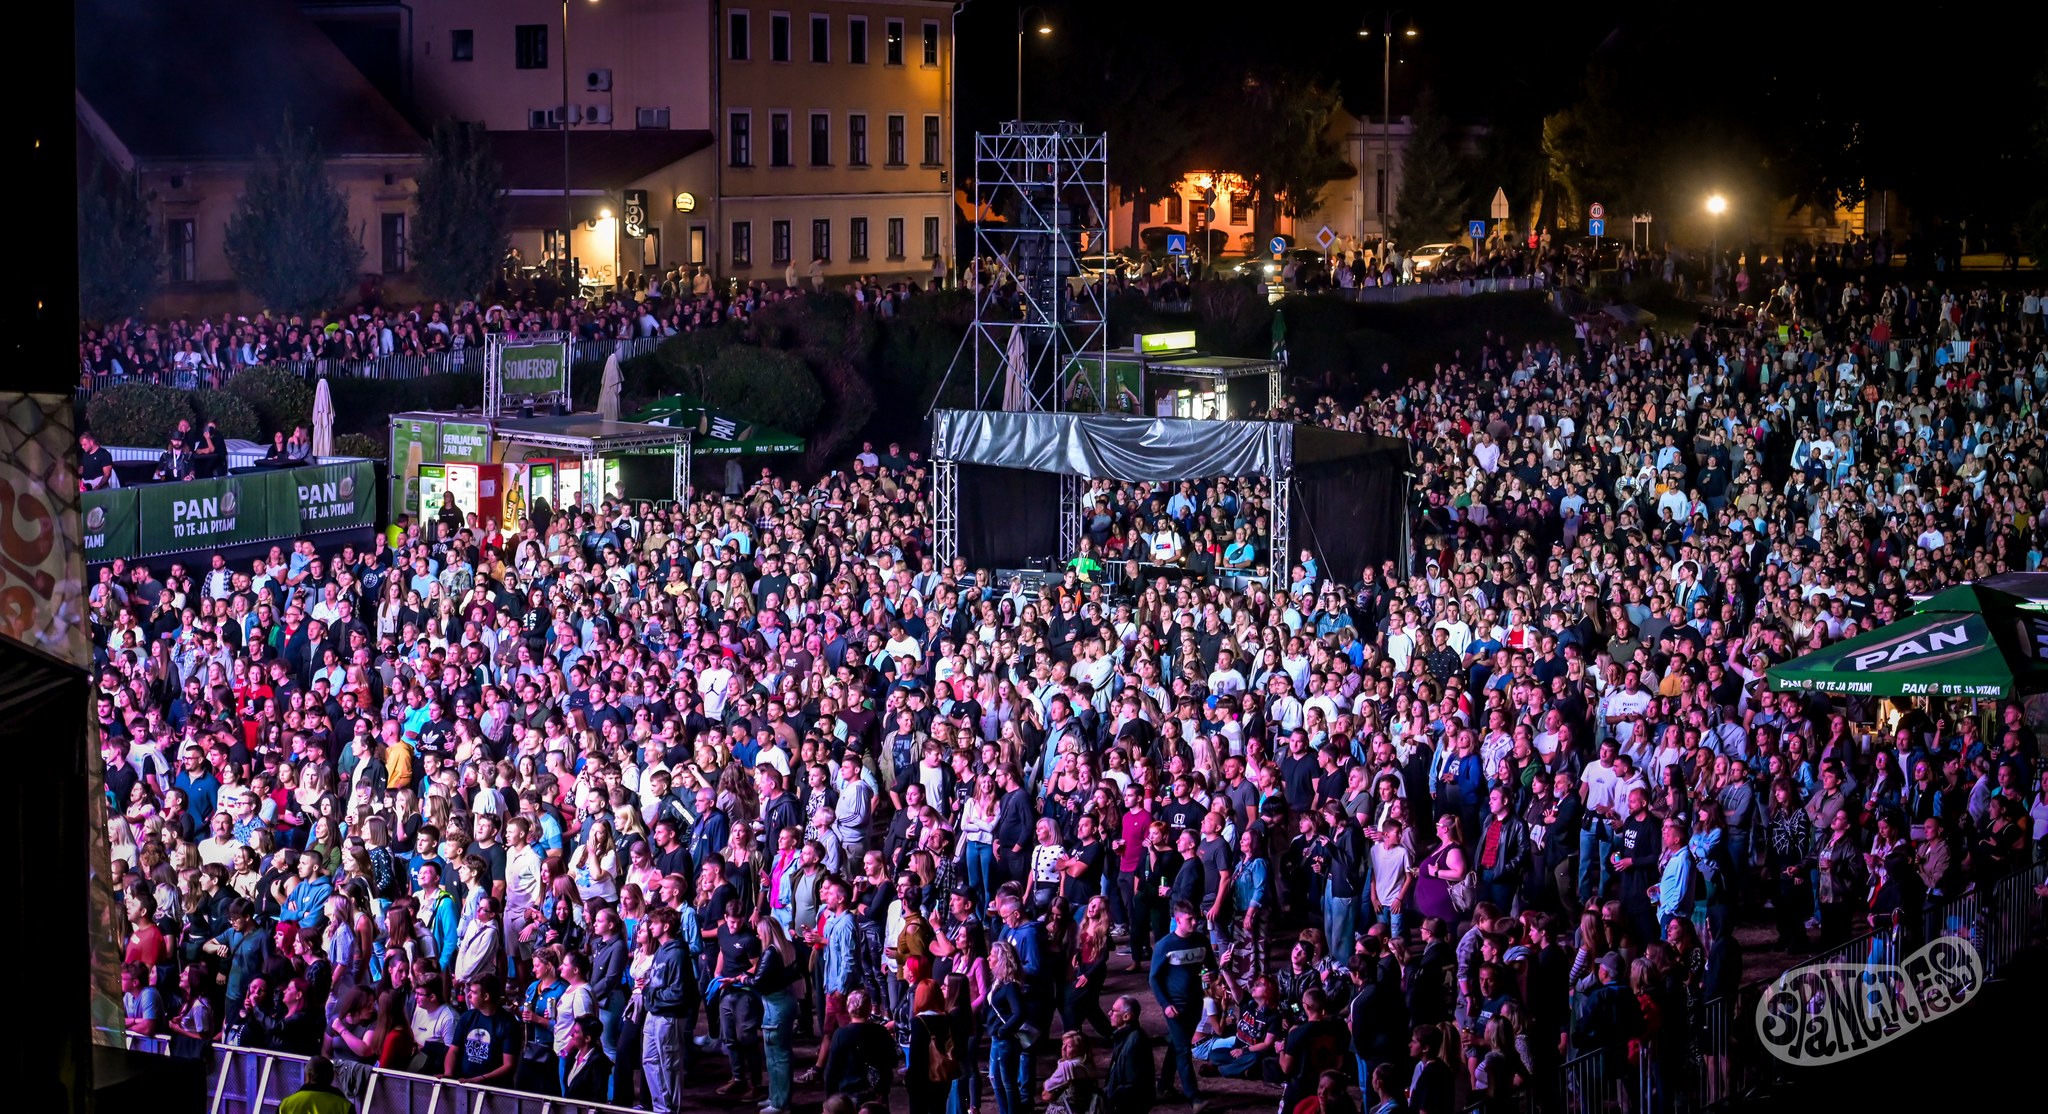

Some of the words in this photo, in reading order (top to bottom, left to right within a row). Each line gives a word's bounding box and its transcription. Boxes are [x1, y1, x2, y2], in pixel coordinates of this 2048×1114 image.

[505, 358, 558, 379] SOMERSBY
[710, 416, 736, 440] PAN
[443, 445, 457, 454] ZAR
[298, 482, 336, 505] PAN
[173, 497, 217, 522] PAN
[309, 507, 317, 519] TE
[319, 505, 328, 518] JA
[330, 502, 354, 517] PITAM!
[174, 524, 184, 538] TO
[186, 523, 195, 536] TE
[197, 521, 208, 534] JA
[211, 517, 236, 533] PITAM!
[84, 534, 104, 549] TAM!
[1855, 625, 1969, 671] PAN
[1816, 681, 1825, 690] TO
[1827, 682, 1835, 690] TE
[1836, 682, 1846, 691] JA
[1847, 682, 1872, 692] PITAM!
[1902, 683, 1927, 694] PAN
[1942, 684, 1952, 694] TO
[1953, 685, 1962, 694] TE
[1964, 686, 1974, 694] JA
[1976, 686, 2000, 695] PITAM!
